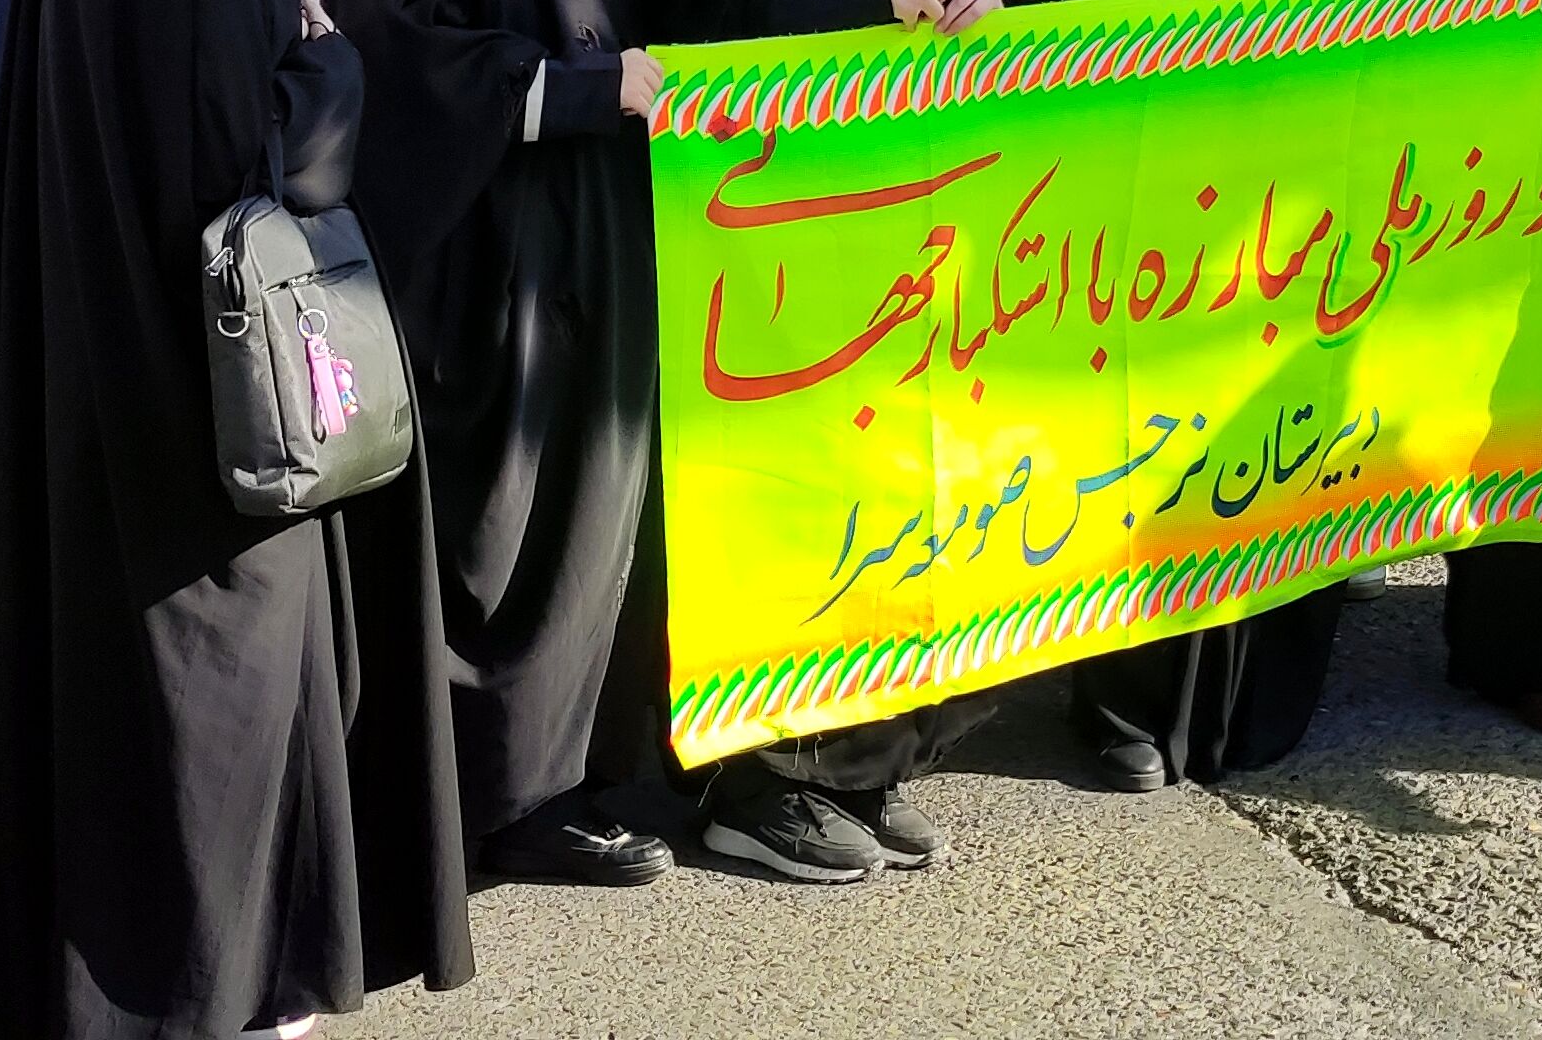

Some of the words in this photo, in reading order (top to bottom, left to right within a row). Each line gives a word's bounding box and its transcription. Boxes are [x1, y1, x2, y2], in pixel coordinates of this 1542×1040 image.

[1128, 183, 1334, 348] مبارزه
[1316, 142, 1423, 337] ملی
[1408, 146, 1523, 265] روز
[895, 157, 1072, 405] استکبار
[1087, 224, 1117, 374] با
[891, 455, 1032, 590] صومعه
[1022, 412, 1209, 567] نرجس
[1211, 403, 1380, 519] دبیرستان
[799, 500, 924, 627] سرا
